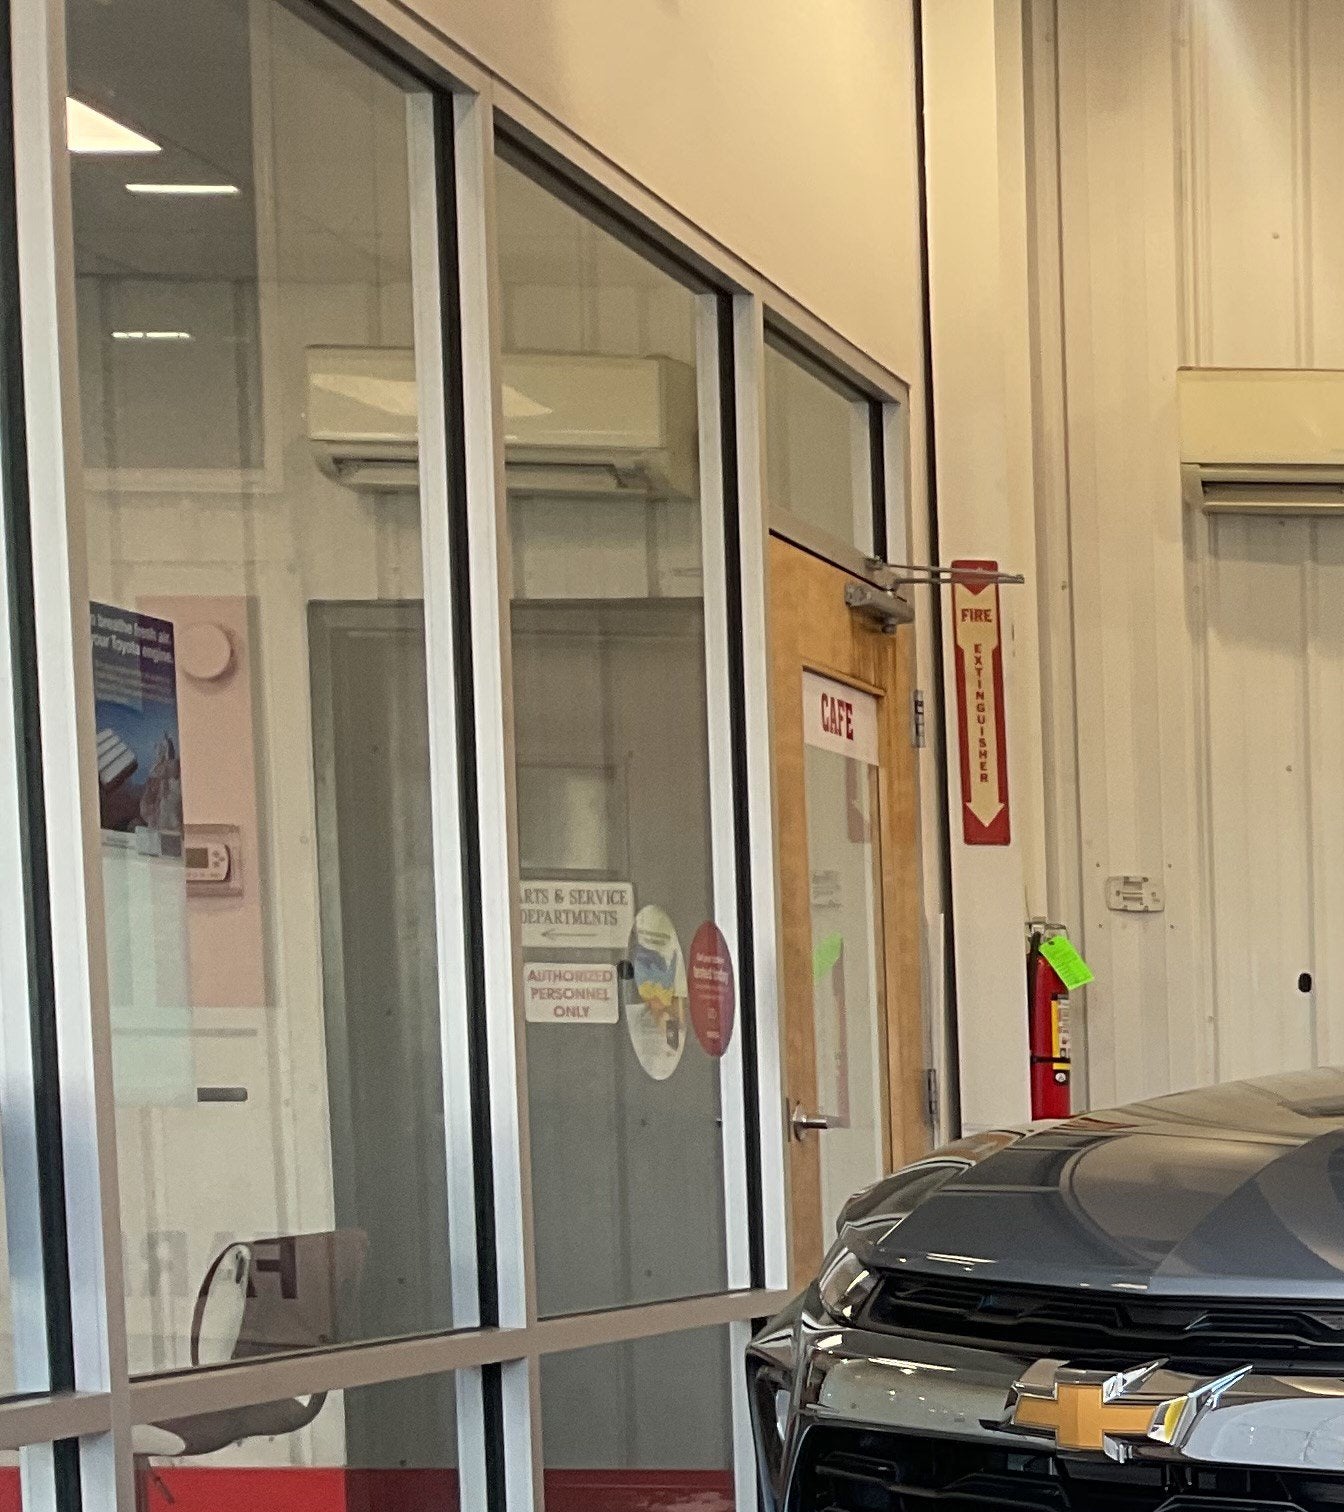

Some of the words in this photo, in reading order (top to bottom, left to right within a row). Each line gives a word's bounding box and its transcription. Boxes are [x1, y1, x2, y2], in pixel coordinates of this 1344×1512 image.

[961, 608, 992, 622] FIRE
[821, 693, 854, 741] CAFE
[974, 643, 989, 783] EXTINGUISHER
[554, 888, 564, 904] &
[568, 889, 629, 906] SERVICE
[520, 908, 618, 926] DEPARTMENTS
[527, 969, 613, 983] AUTHORIZED
[530, 987, 610, 1001] PERSONNEL
[553, 1005, 591, 1018] ONLY
